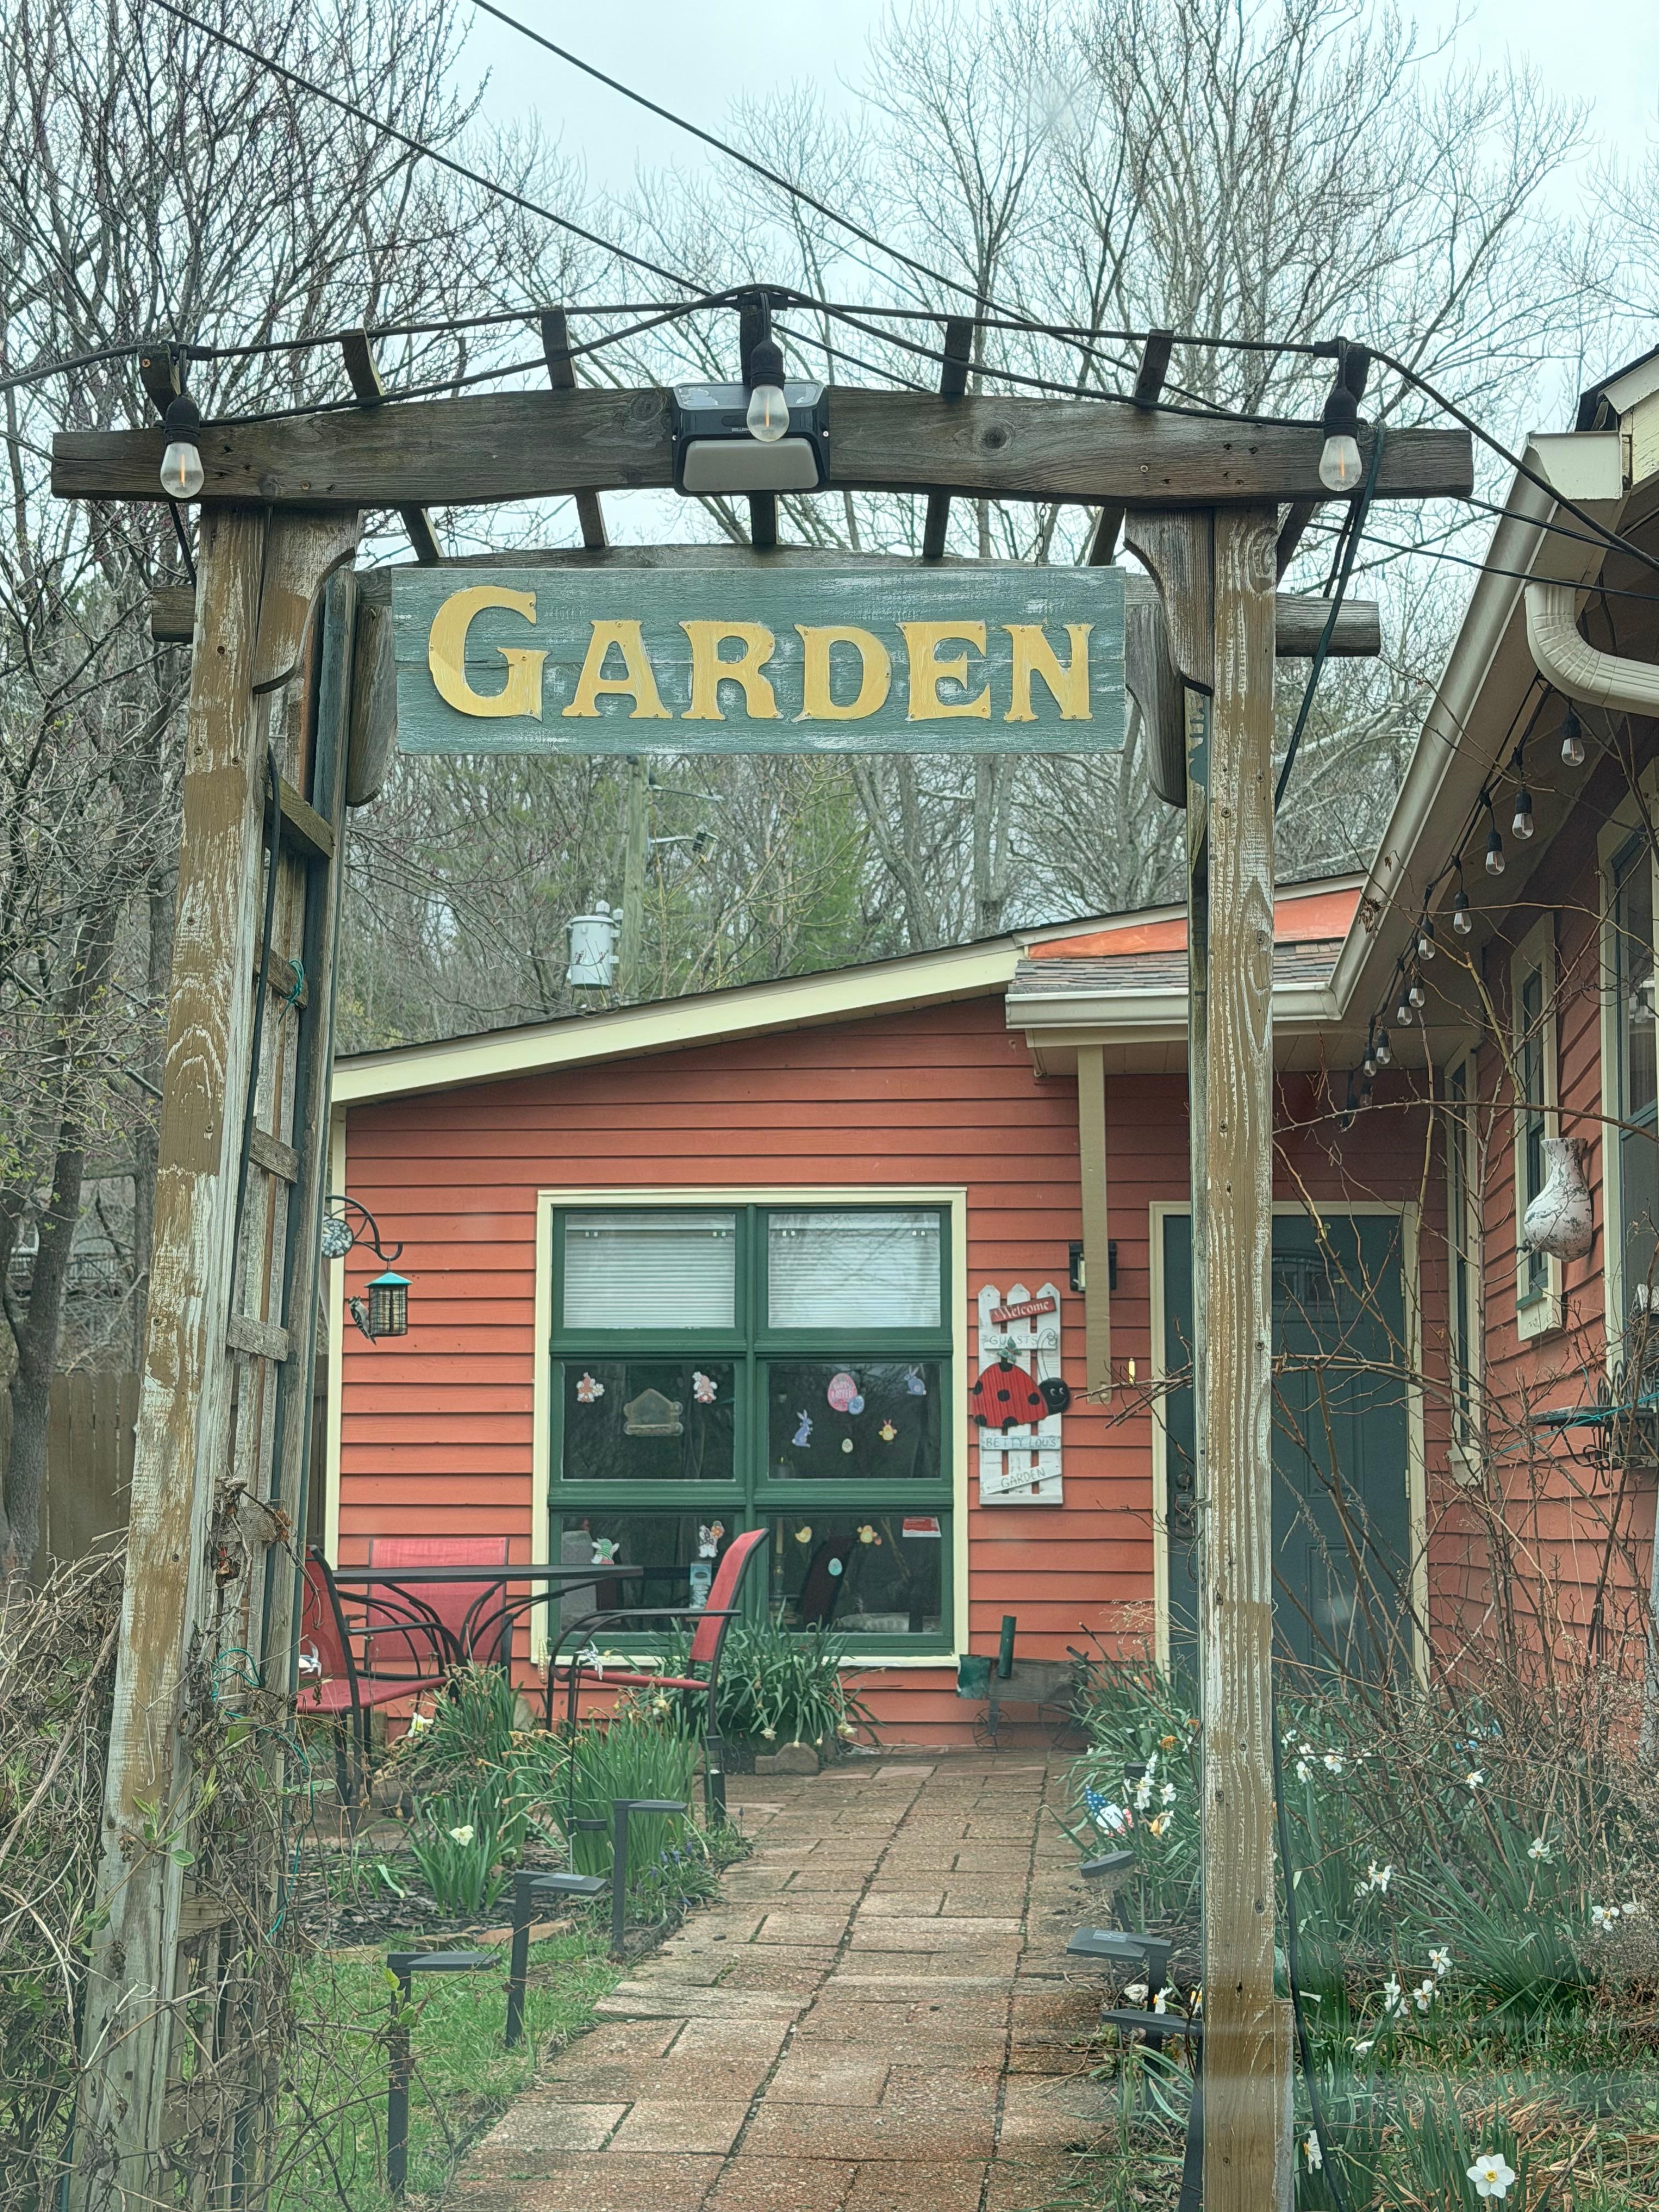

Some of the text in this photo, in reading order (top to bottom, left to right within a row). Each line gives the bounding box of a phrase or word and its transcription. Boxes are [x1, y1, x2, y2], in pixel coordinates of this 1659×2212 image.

[429, 585, 1094, 722] GARDEN
[994, 1301, 1049, 1320] Welcome
[989, 1335, 1037, 1345] GUSTS
[986, 1436, 1024, 1448] BETTY
[1001, 1468, 1046, 1488] GARDEN
